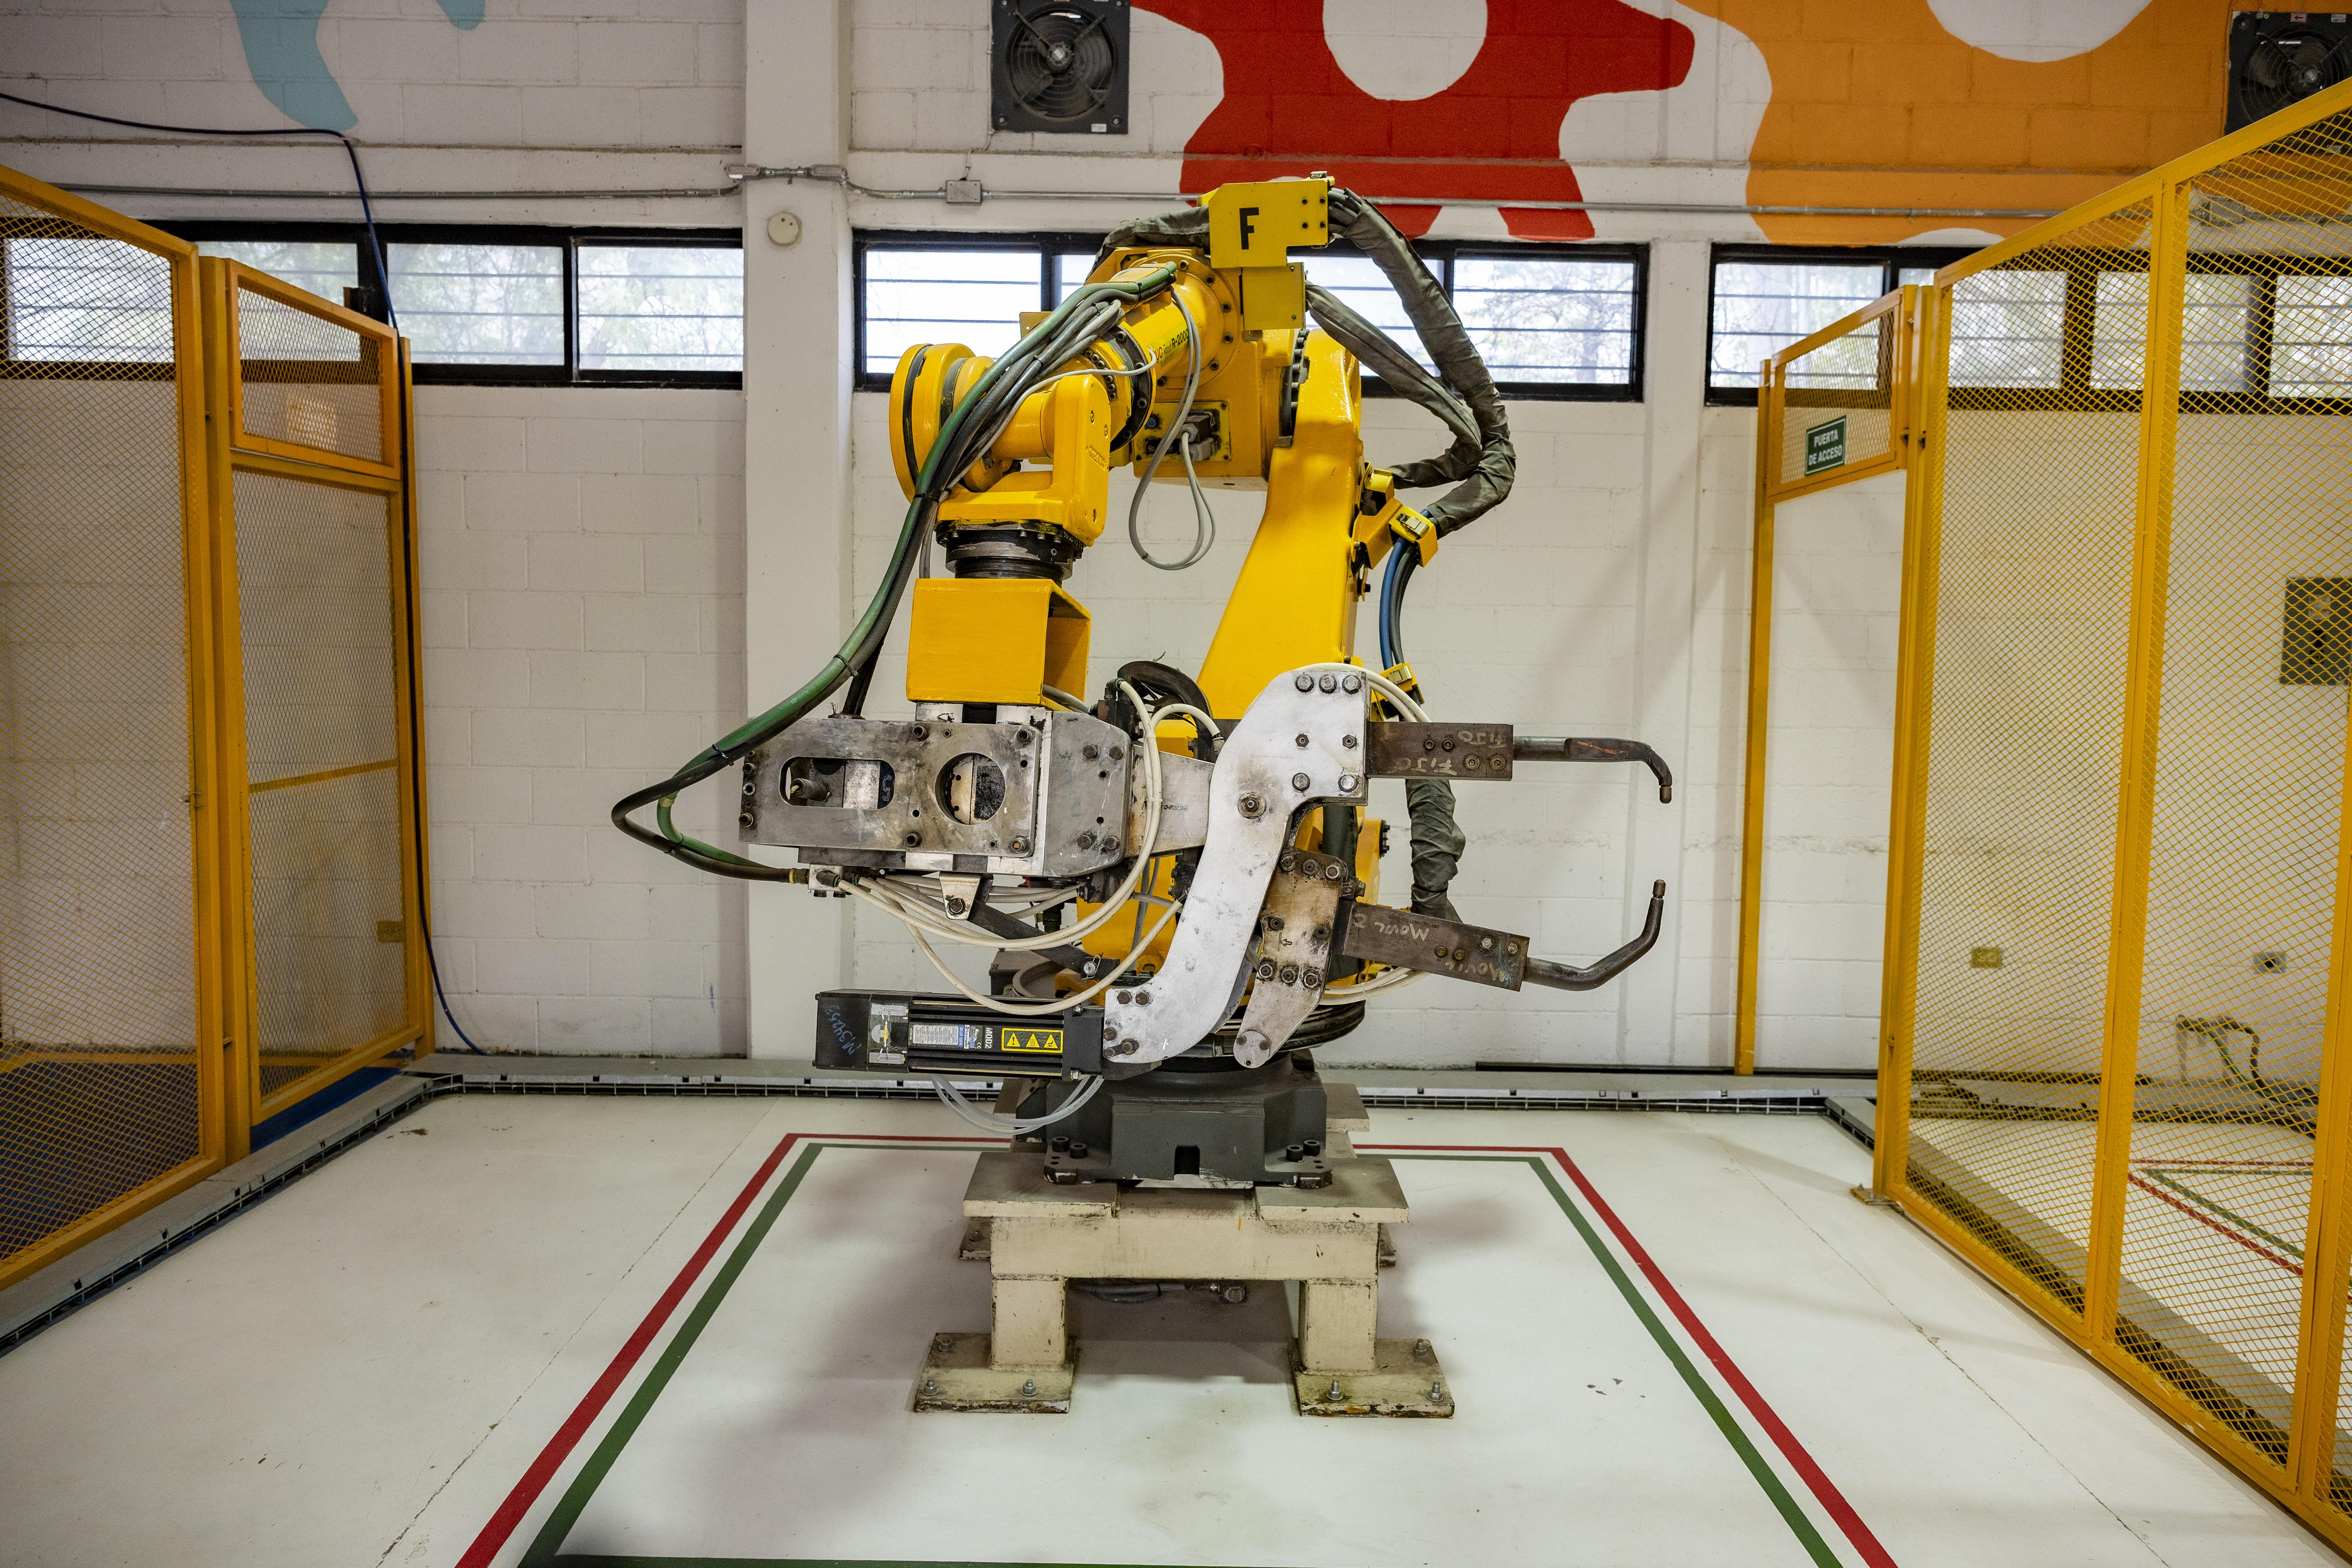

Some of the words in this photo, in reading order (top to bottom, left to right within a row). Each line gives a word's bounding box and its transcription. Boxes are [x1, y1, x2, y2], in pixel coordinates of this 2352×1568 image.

[1239, 206, 1260, 250] F
[1814, 429, 1838, 448] PUERTA
[1808, 454, 1818, 466] DE
[1818, 445, 1843, 463] ACCESO
[1458, 730, 1508, 749] FIJO
[1394, 757, 1458, 776] FIJO
[985, 1027, 993, 1049] MOD2
